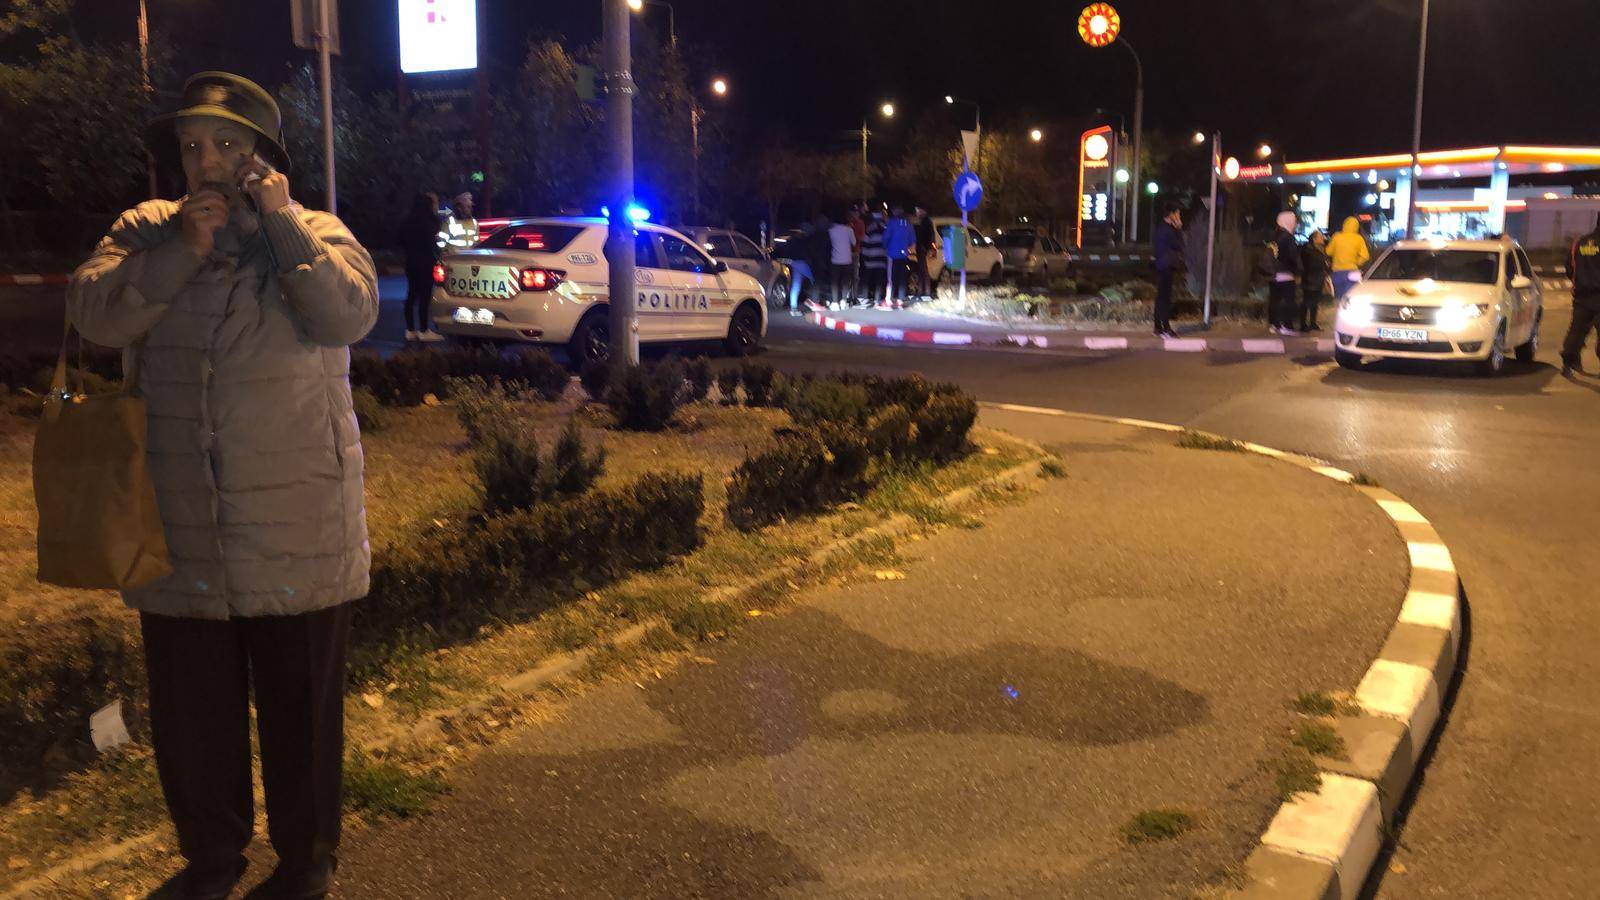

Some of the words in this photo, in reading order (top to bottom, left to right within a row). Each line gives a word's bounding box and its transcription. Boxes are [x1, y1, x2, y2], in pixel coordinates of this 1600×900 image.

[450, 278, 507, 292] POLITIA
[638, 292, 708, 309] POLITIA
[1391, 330, 1402, 338] 66
[1405, 330, 1423, 339] YZN
